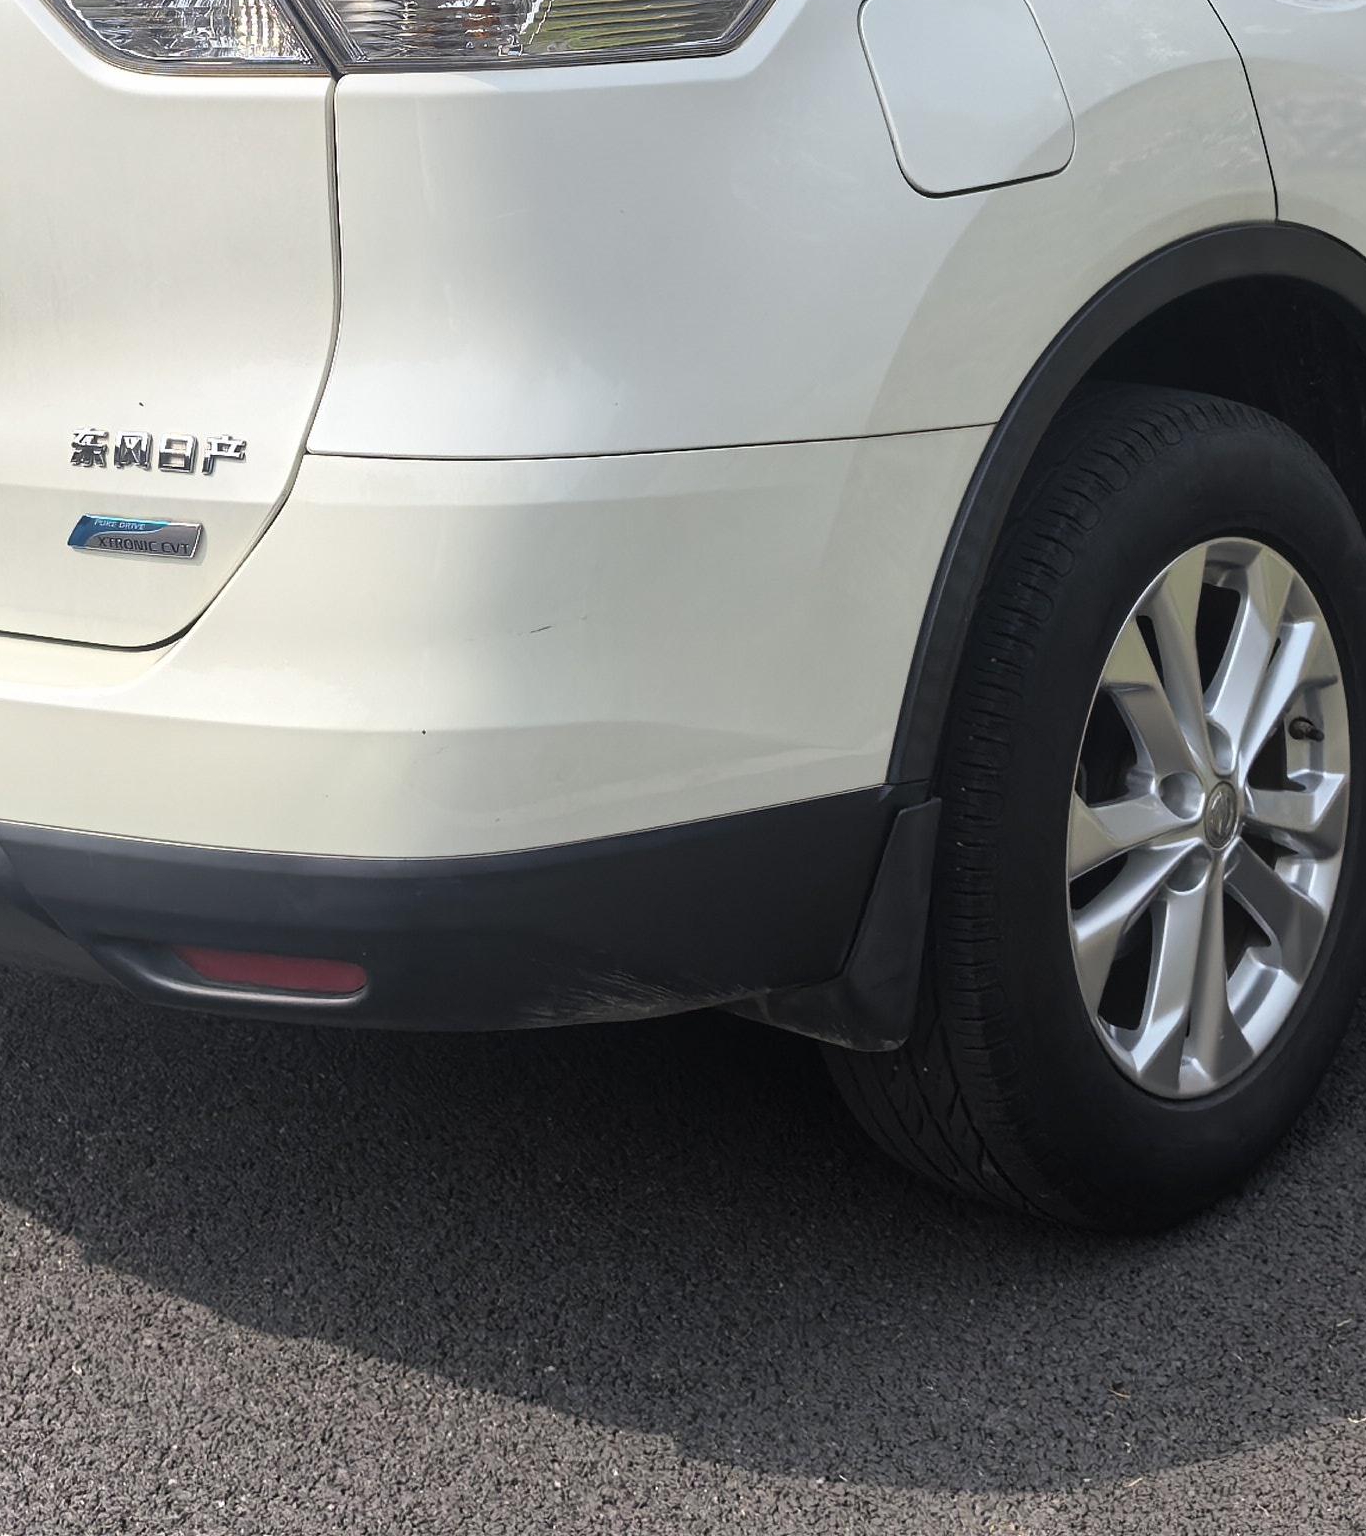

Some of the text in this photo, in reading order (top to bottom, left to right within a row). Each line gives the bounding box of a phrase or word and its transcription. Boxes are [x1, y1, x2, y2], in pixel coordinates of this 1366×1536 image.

[71, 427, 247, 475] 东风日产
[119, 521, 147, 531] DRIVE
[98, 536, 189, 554] XTRONIC CVT
